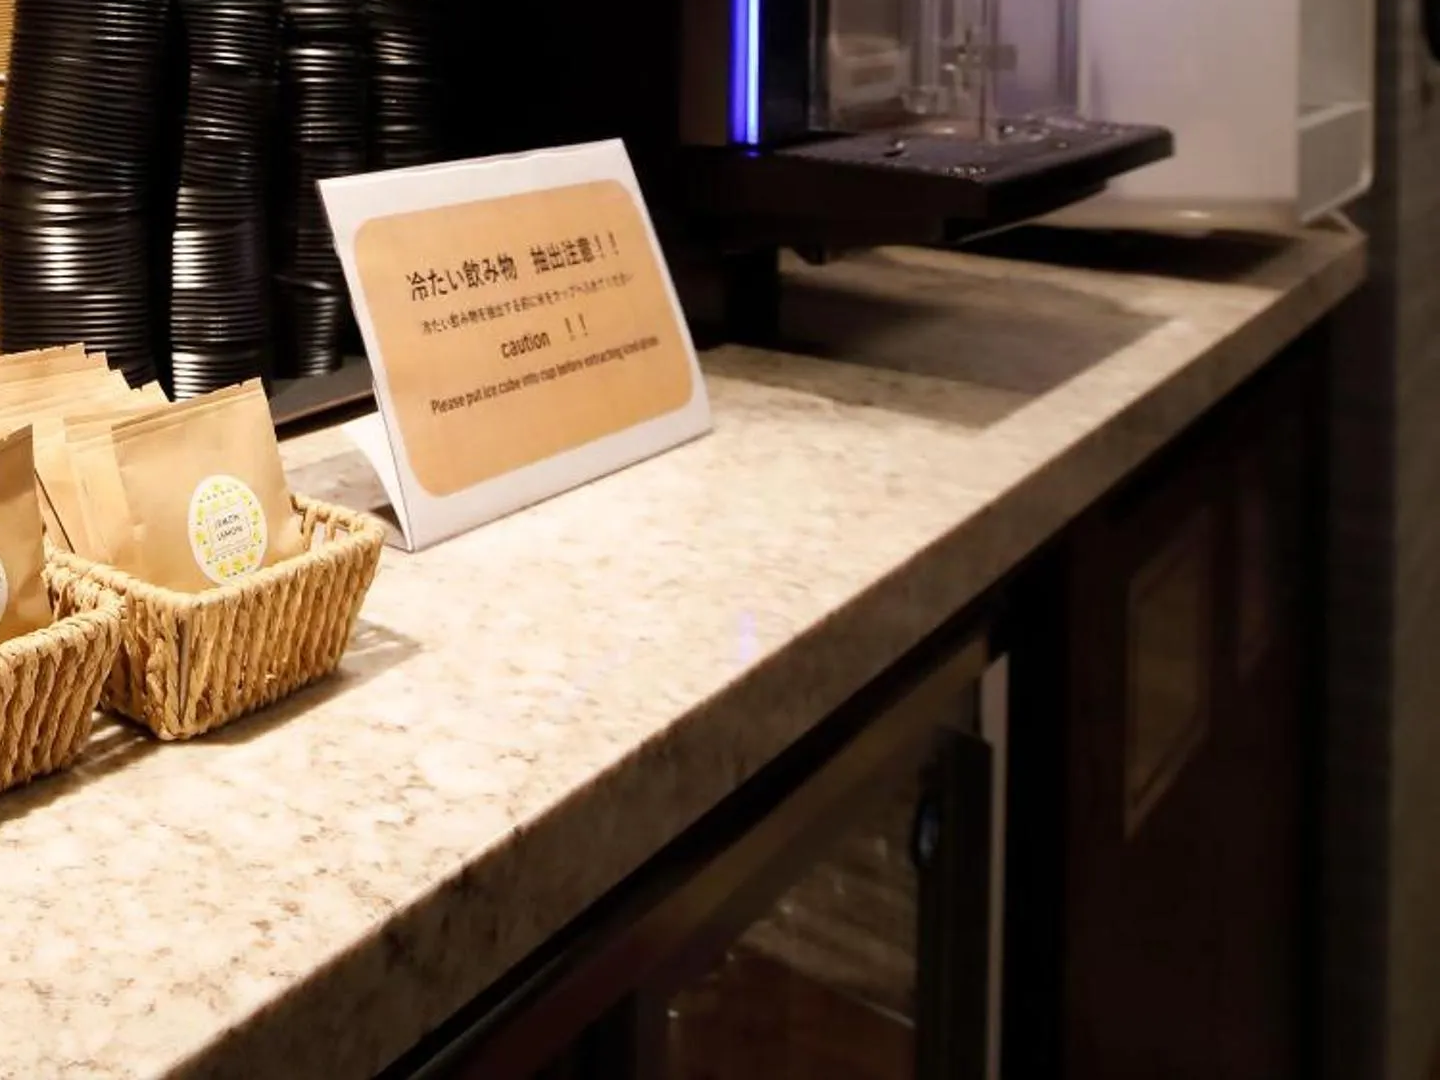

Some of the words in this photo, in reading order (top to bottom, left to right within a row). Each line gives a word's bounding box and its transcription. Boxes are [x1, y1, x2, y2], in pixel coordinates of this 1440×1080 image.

[406, 252, 519, 302] 冷たい飲み物
[500, 331, 551, 359] caution
[430, 393, 466, 415] Please
